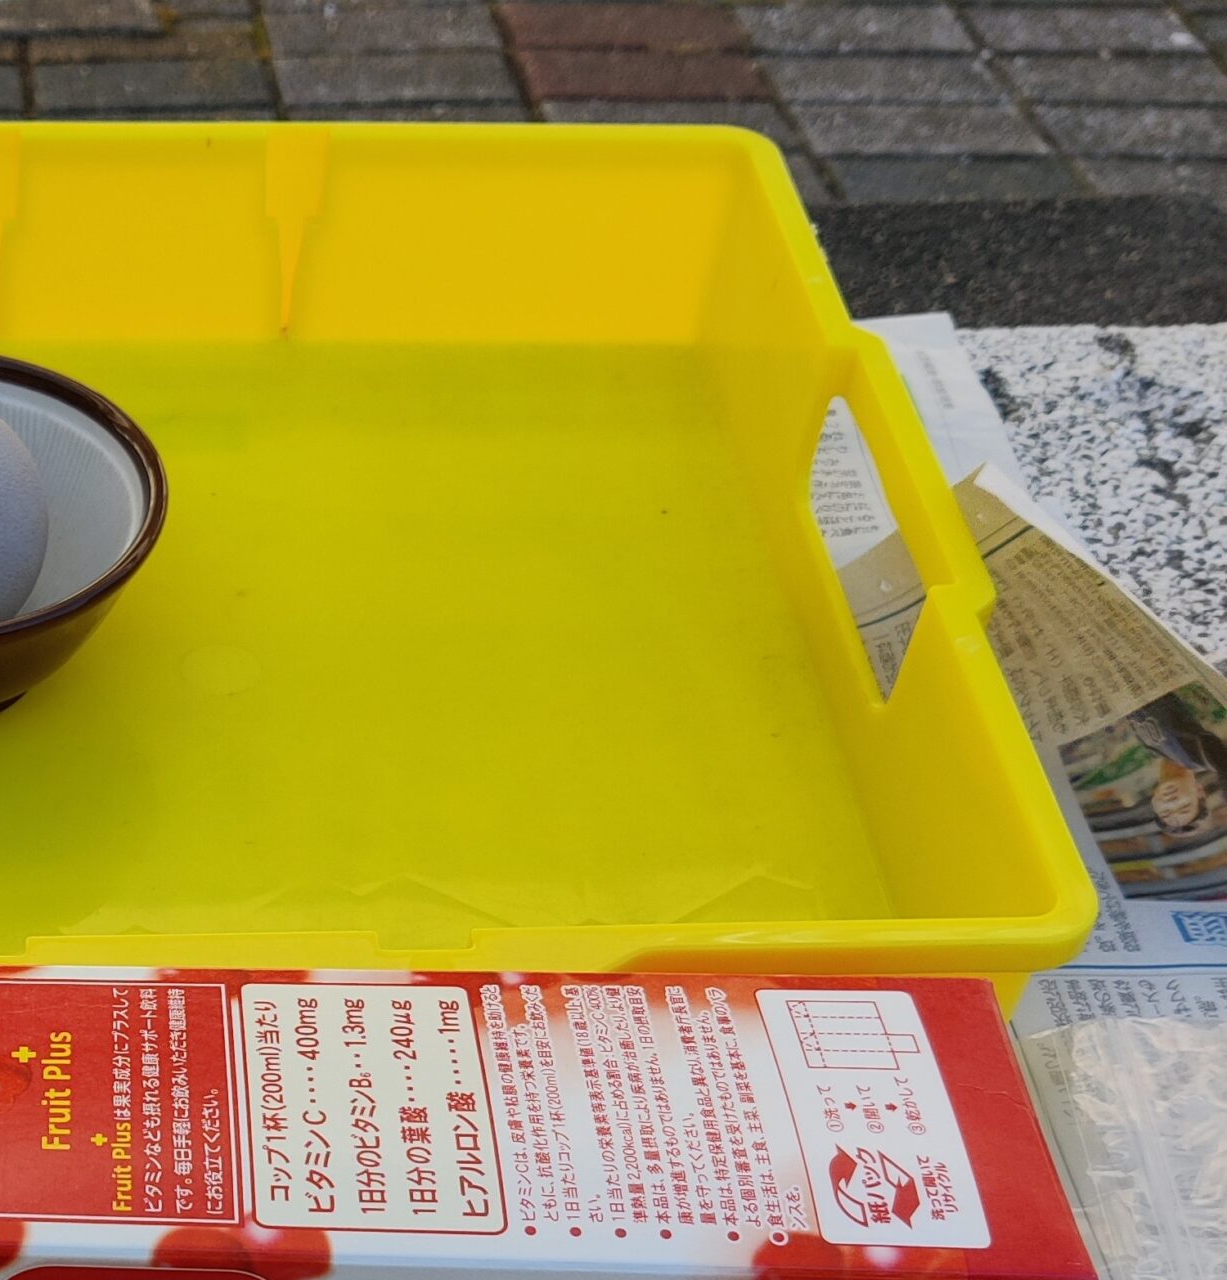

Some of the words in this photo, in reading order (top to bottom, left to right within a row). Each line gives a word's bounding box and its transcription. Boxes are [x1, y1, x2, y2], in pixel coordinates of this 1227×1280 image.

[42, 1031, 72, 1080] Plus
[42, 1088, 71, 1150] Fruit
[203, 1089, 223, 1215] にお役立てください。
[685, 1113, 716, 1225] 量を守ってください。
[112, 1166, 132, 1211] Fruit
[856, 1147, 892, 1224] 紙パック
[917, 1155, 946, 1220] 洗って開いて
[937, 1163, 958, 1213] リサイクル
